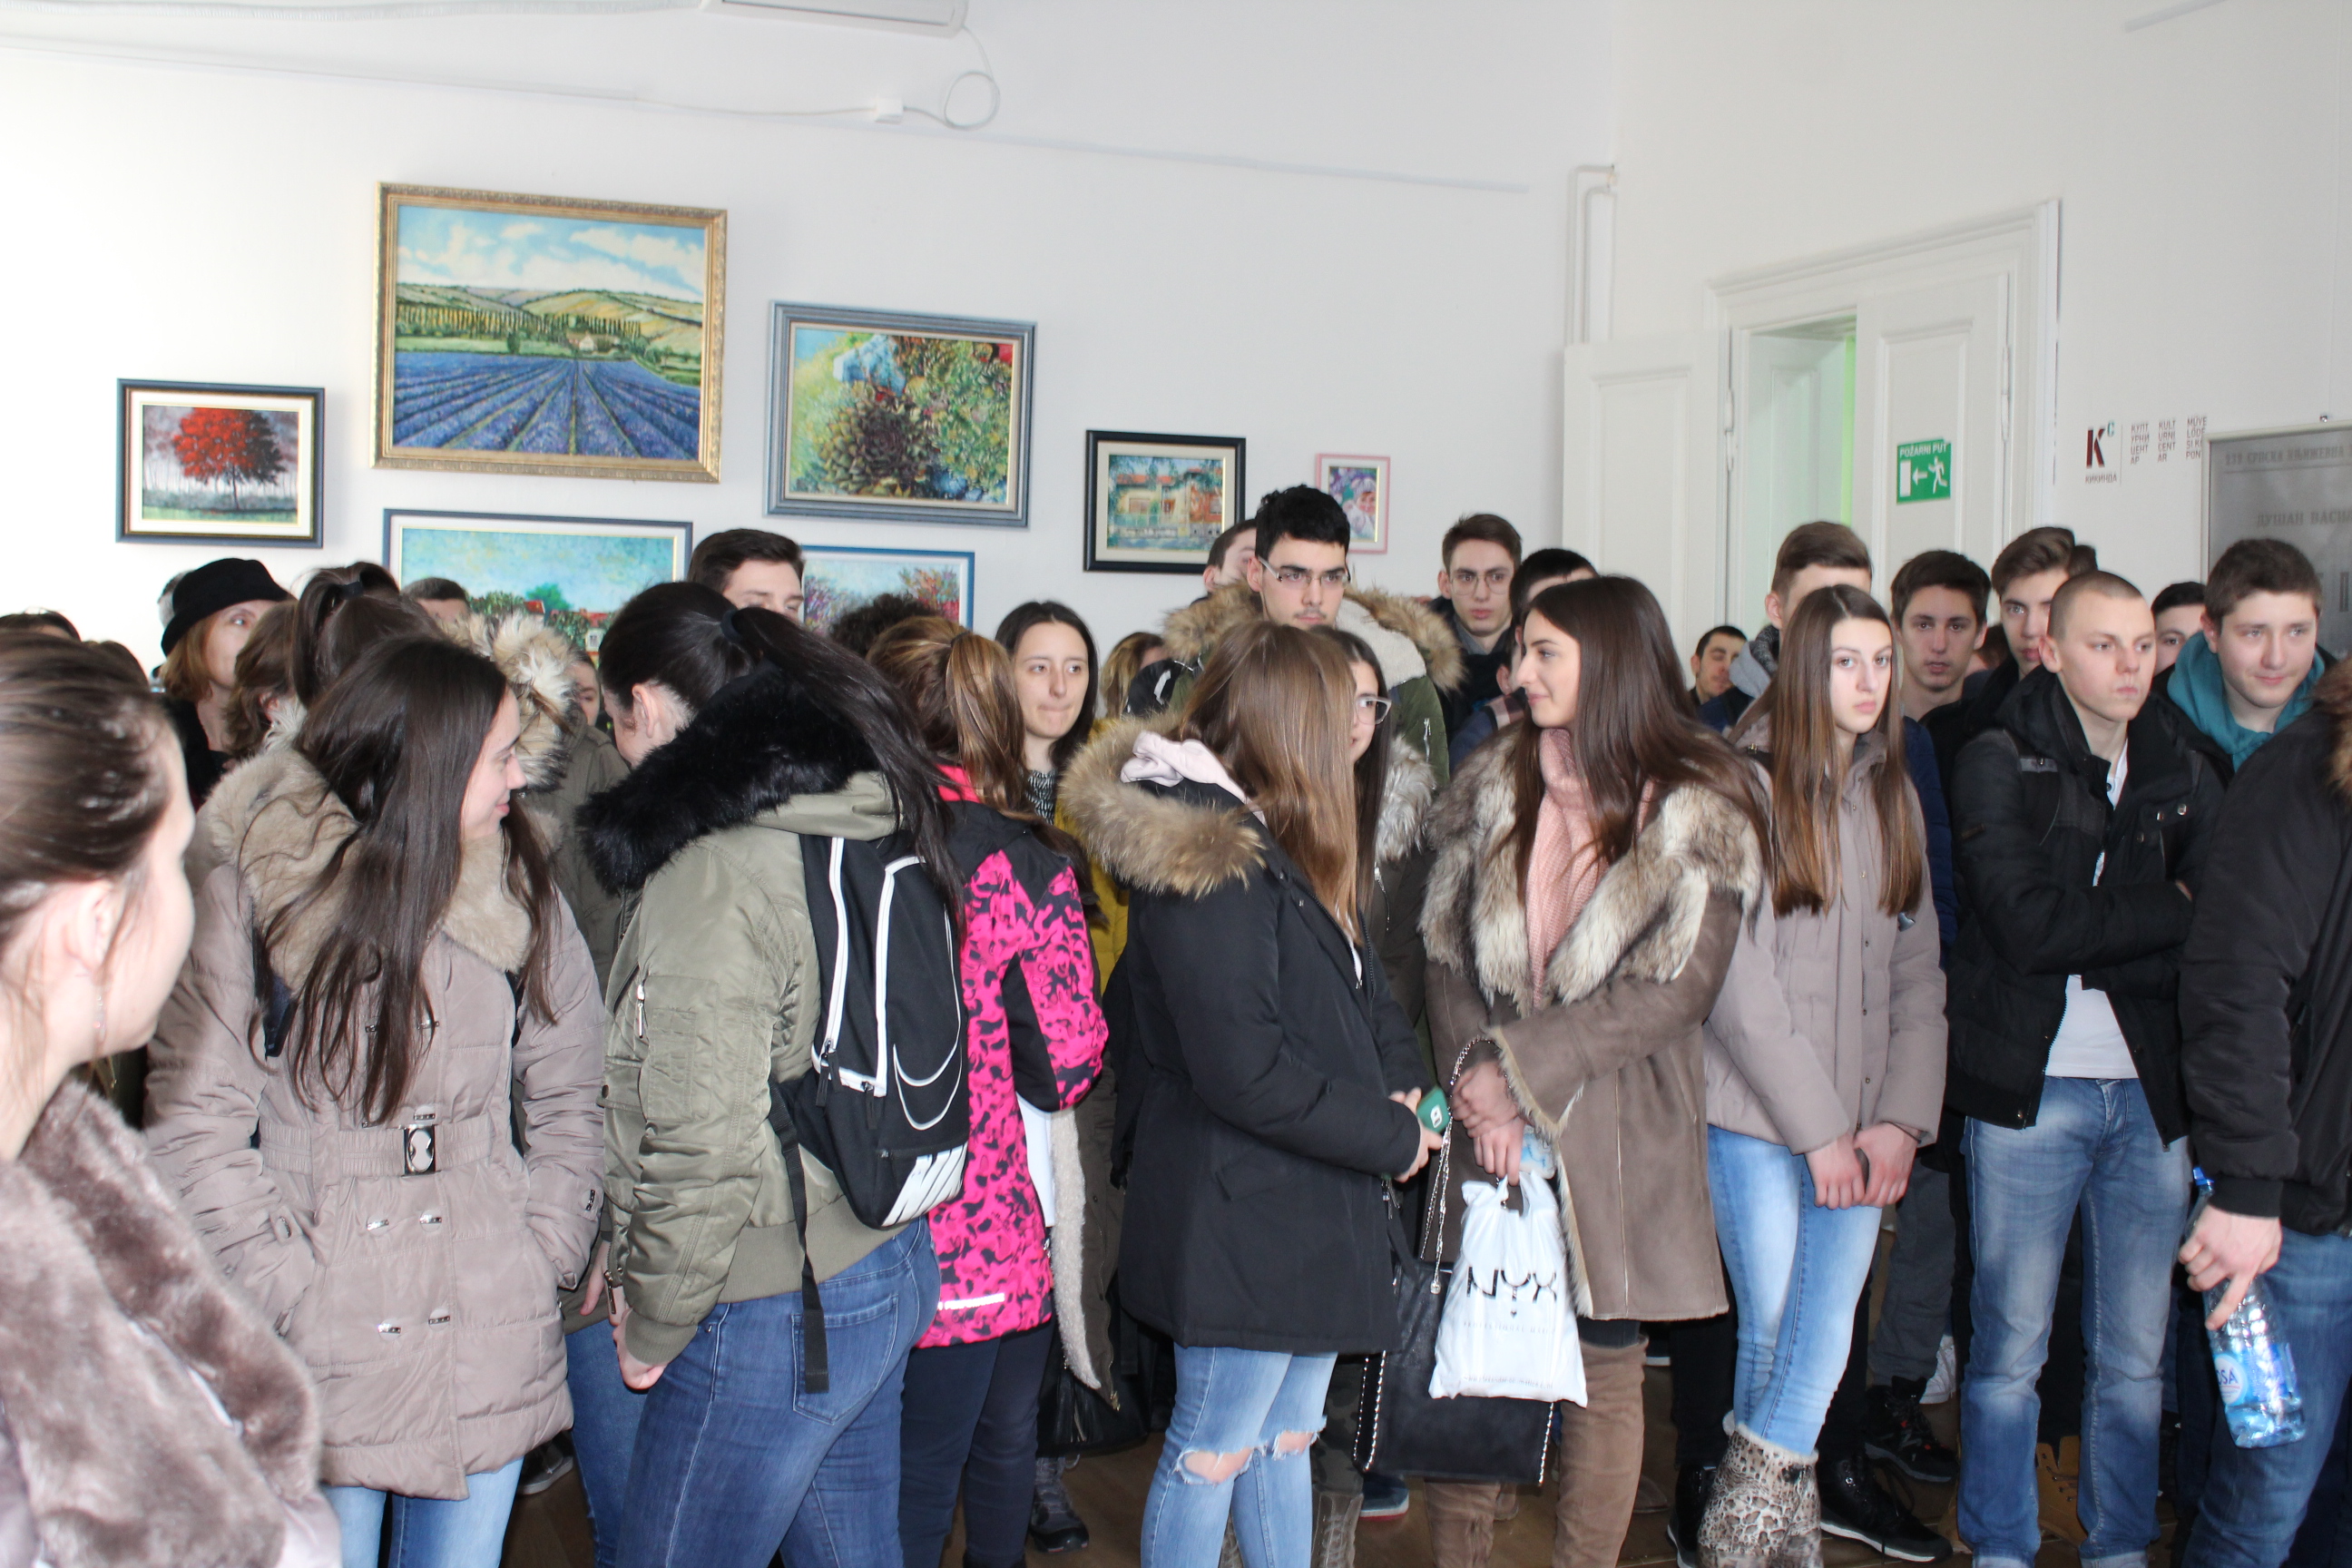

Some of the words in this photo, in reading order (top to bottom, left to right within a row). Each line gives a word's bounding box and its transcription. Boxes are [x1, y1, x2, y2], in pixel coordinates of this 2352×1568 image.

[2158, 419, 2176, 430] KULT
[2158, 431, 2176, 441] URNI
[1932, 442, 1947, 455] PUT
[2158, 442, 2176, 452] CENT
[2158, 453, 2167, 463] AR
[1466, 1266, 1557, 1303] NYX
